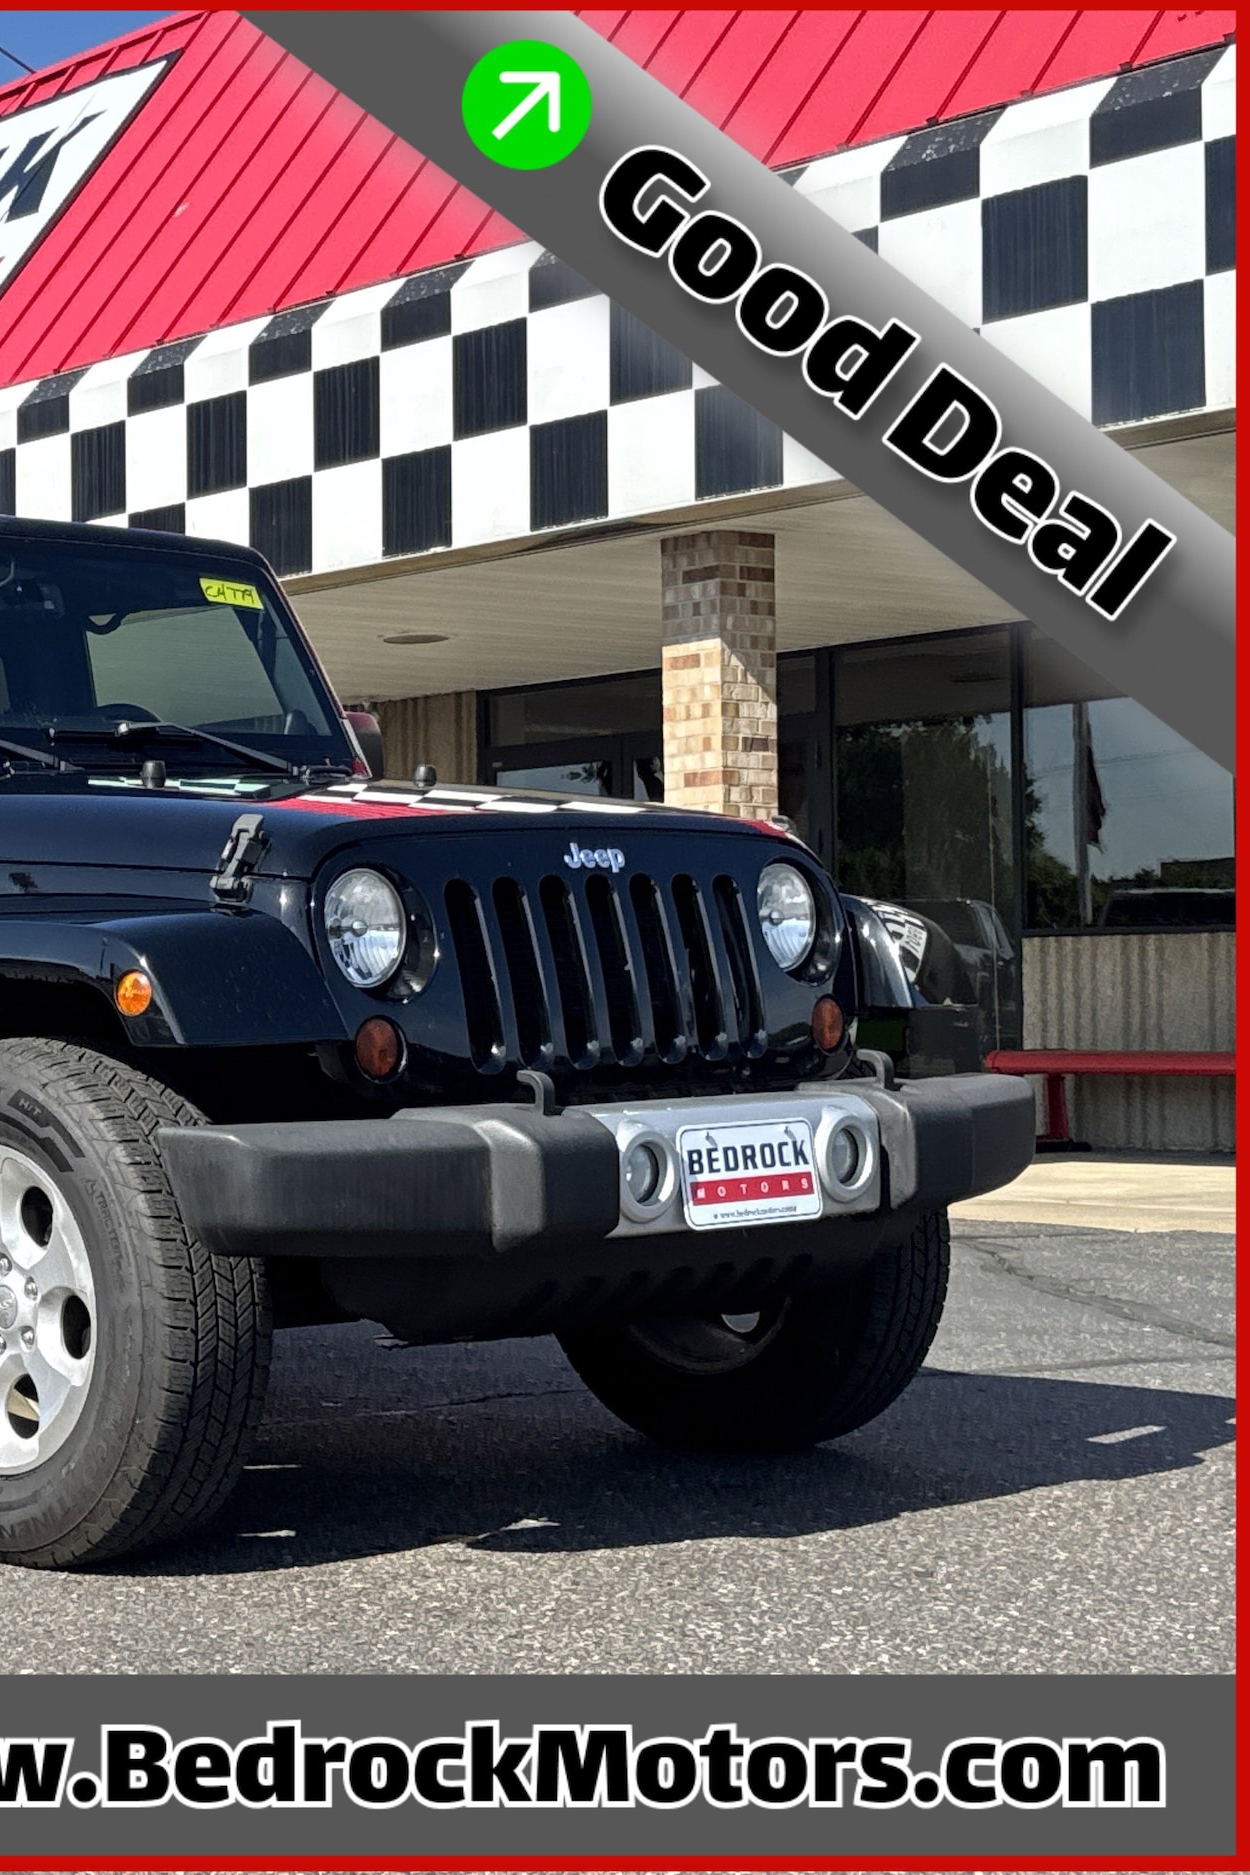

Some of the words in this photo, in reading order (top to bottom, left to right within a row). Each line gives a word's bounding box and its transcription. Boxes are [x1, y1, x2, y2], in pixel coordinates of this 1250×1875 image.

[563, 842, 626, 873] Jeep
[687, 1140, 810, 1175] BEDROCK
[696, 1177, 810, 1200] MOTORS
